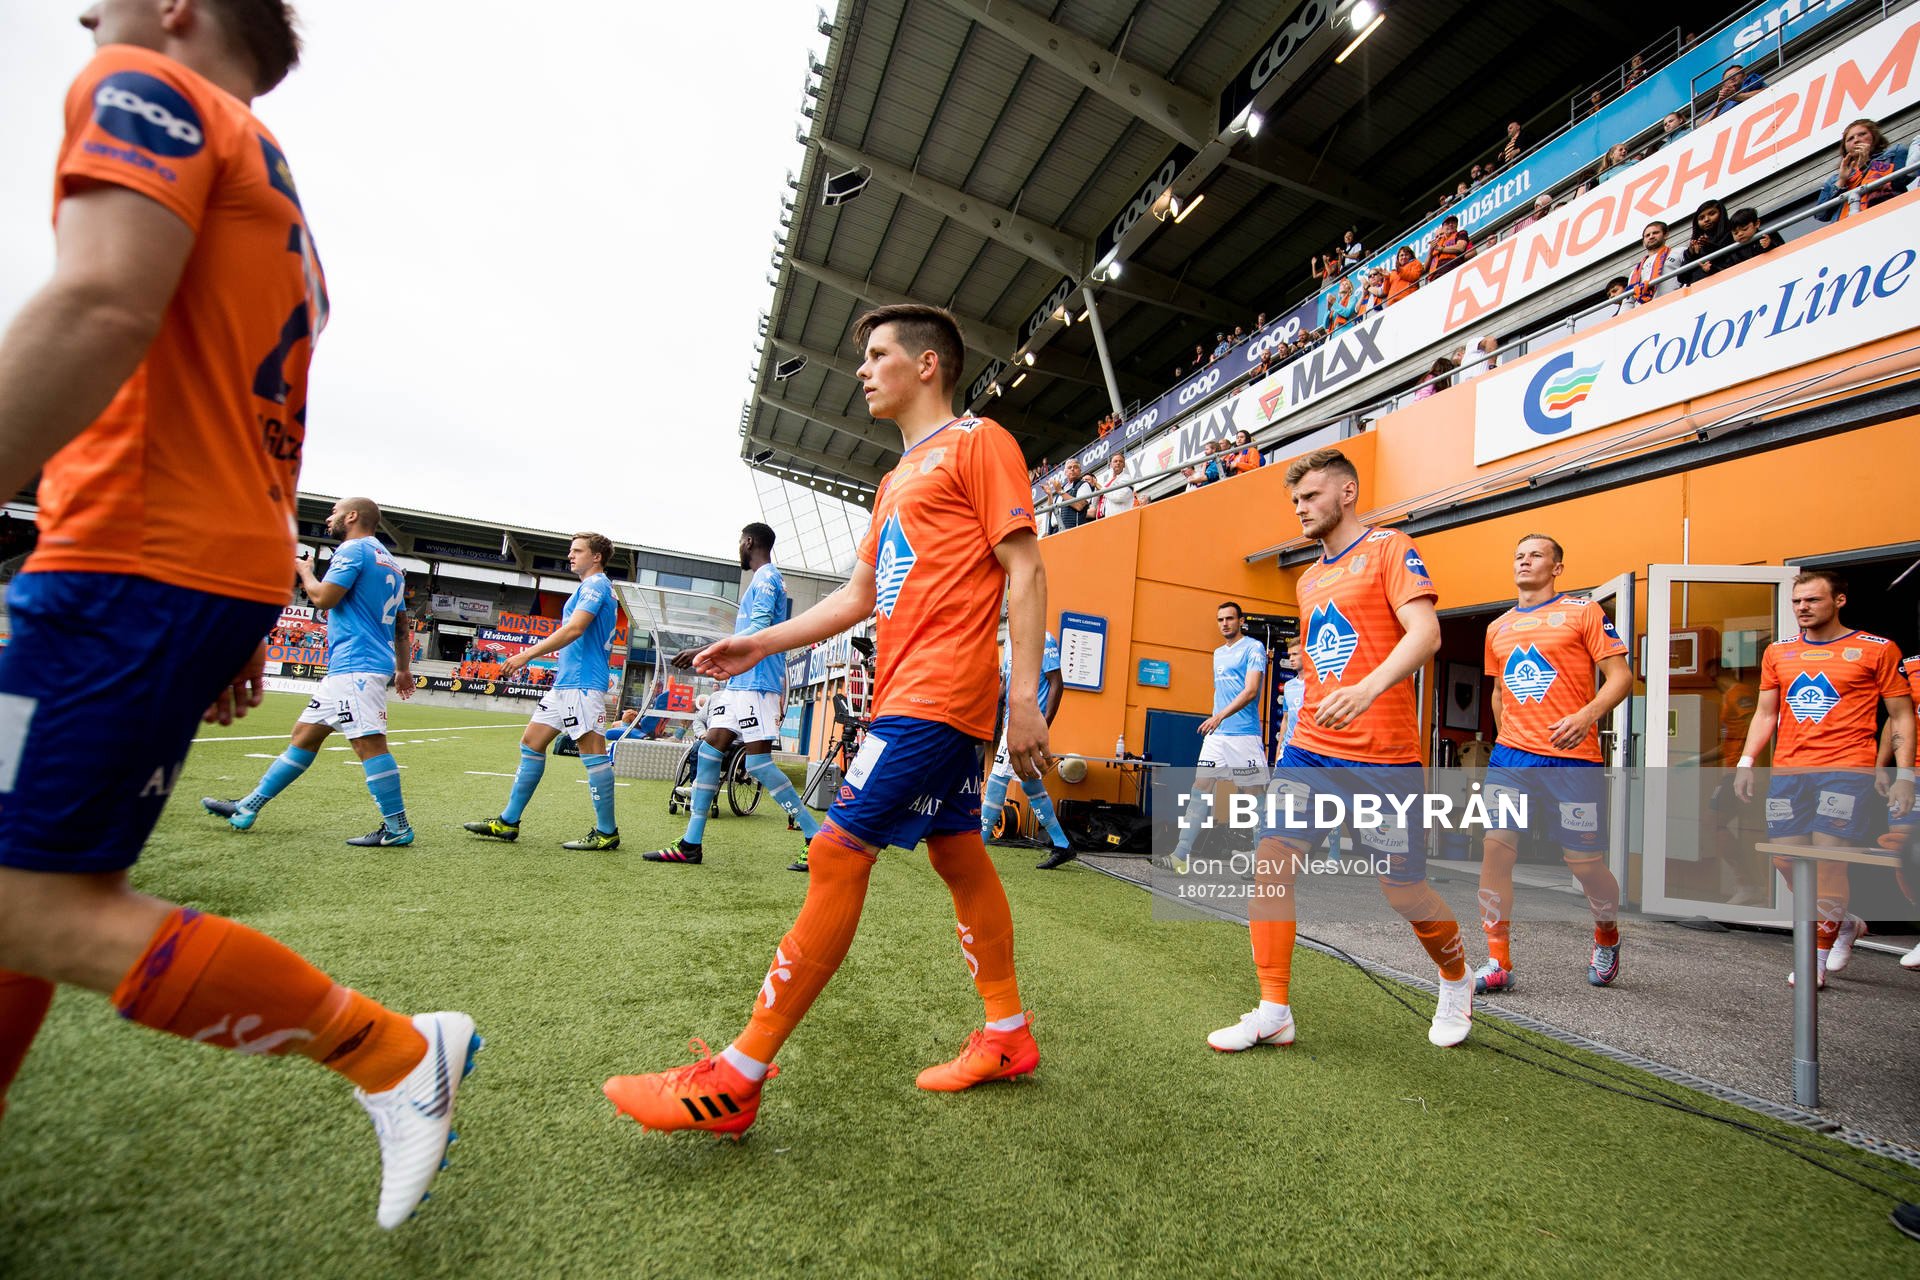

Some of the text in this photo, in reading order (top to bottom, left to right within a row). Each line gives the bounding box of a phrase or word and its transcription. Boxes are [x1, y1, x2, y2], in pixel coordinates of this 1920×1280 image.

[1250, 0, 1337, 90] coo
[1113, 160, 1175, 243] coop
[1029, 280, 1069, 337] coop
[1622, 249, 1916, 385] Color Line
[1247, 316, 1301, 362] coop
[1291, 316, 1384, 406] MAX
[1179, 368, 1220, 405] coop
[1126, 408, 1158, 438] coop
[1178, 397, 1240, 463] MAX
[1082, 440, 1110, 467] coop
[426, 543, 503, 560] www.rolls-royce.co
[338, 699, 350, 711] 24
[749, 705, 755, 716] 2
